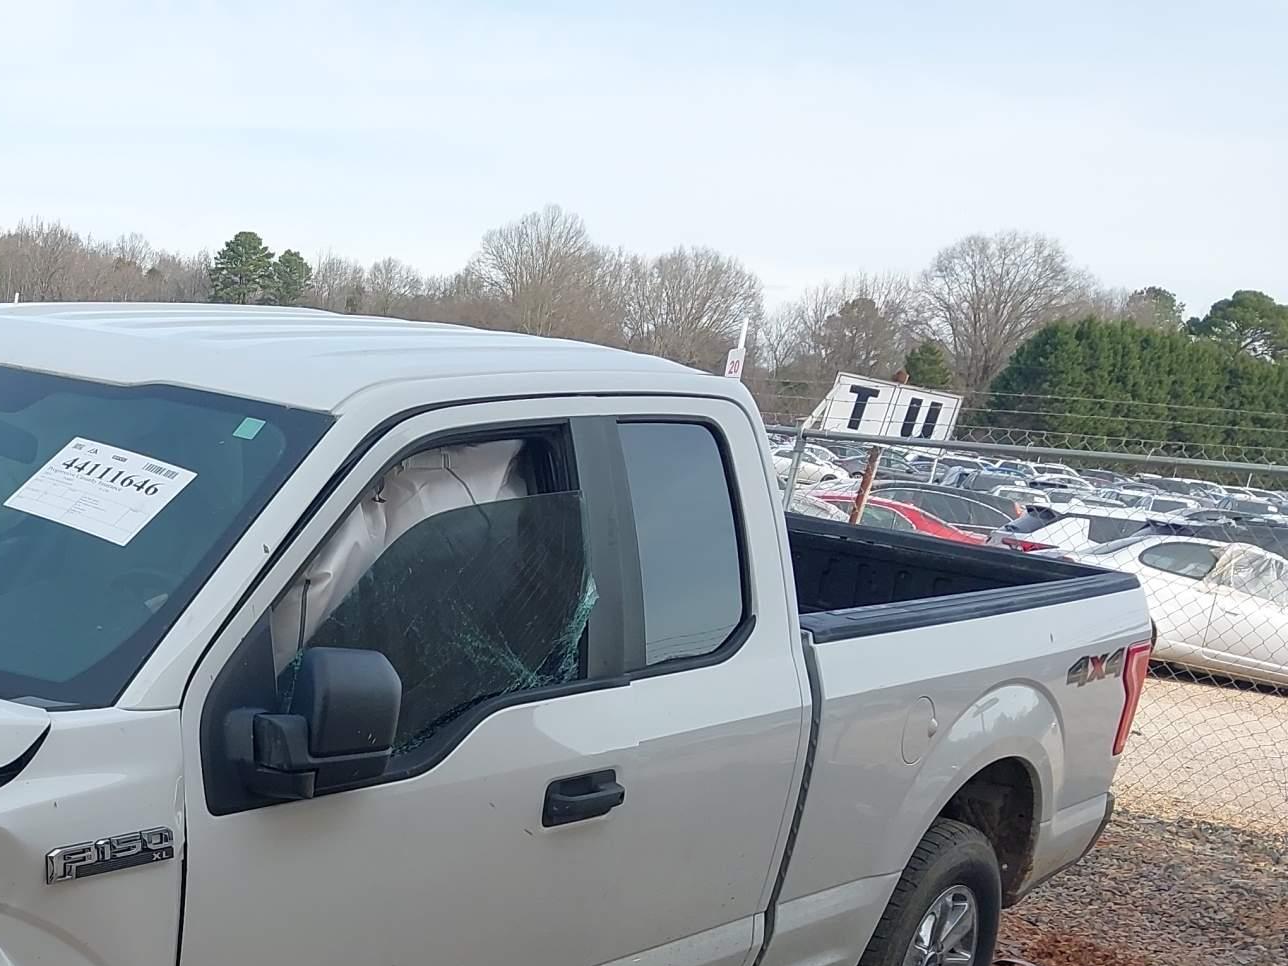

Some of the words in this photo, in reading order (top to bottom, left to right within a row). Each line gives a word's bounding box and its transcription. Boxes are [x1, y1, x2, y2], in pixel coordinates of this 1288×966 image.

[728, 360, 740, 375] 20
[847, 384, 880, 431] T
[62, 457, 165, 496] 44111646
[152, 849, 171, 861] XL
